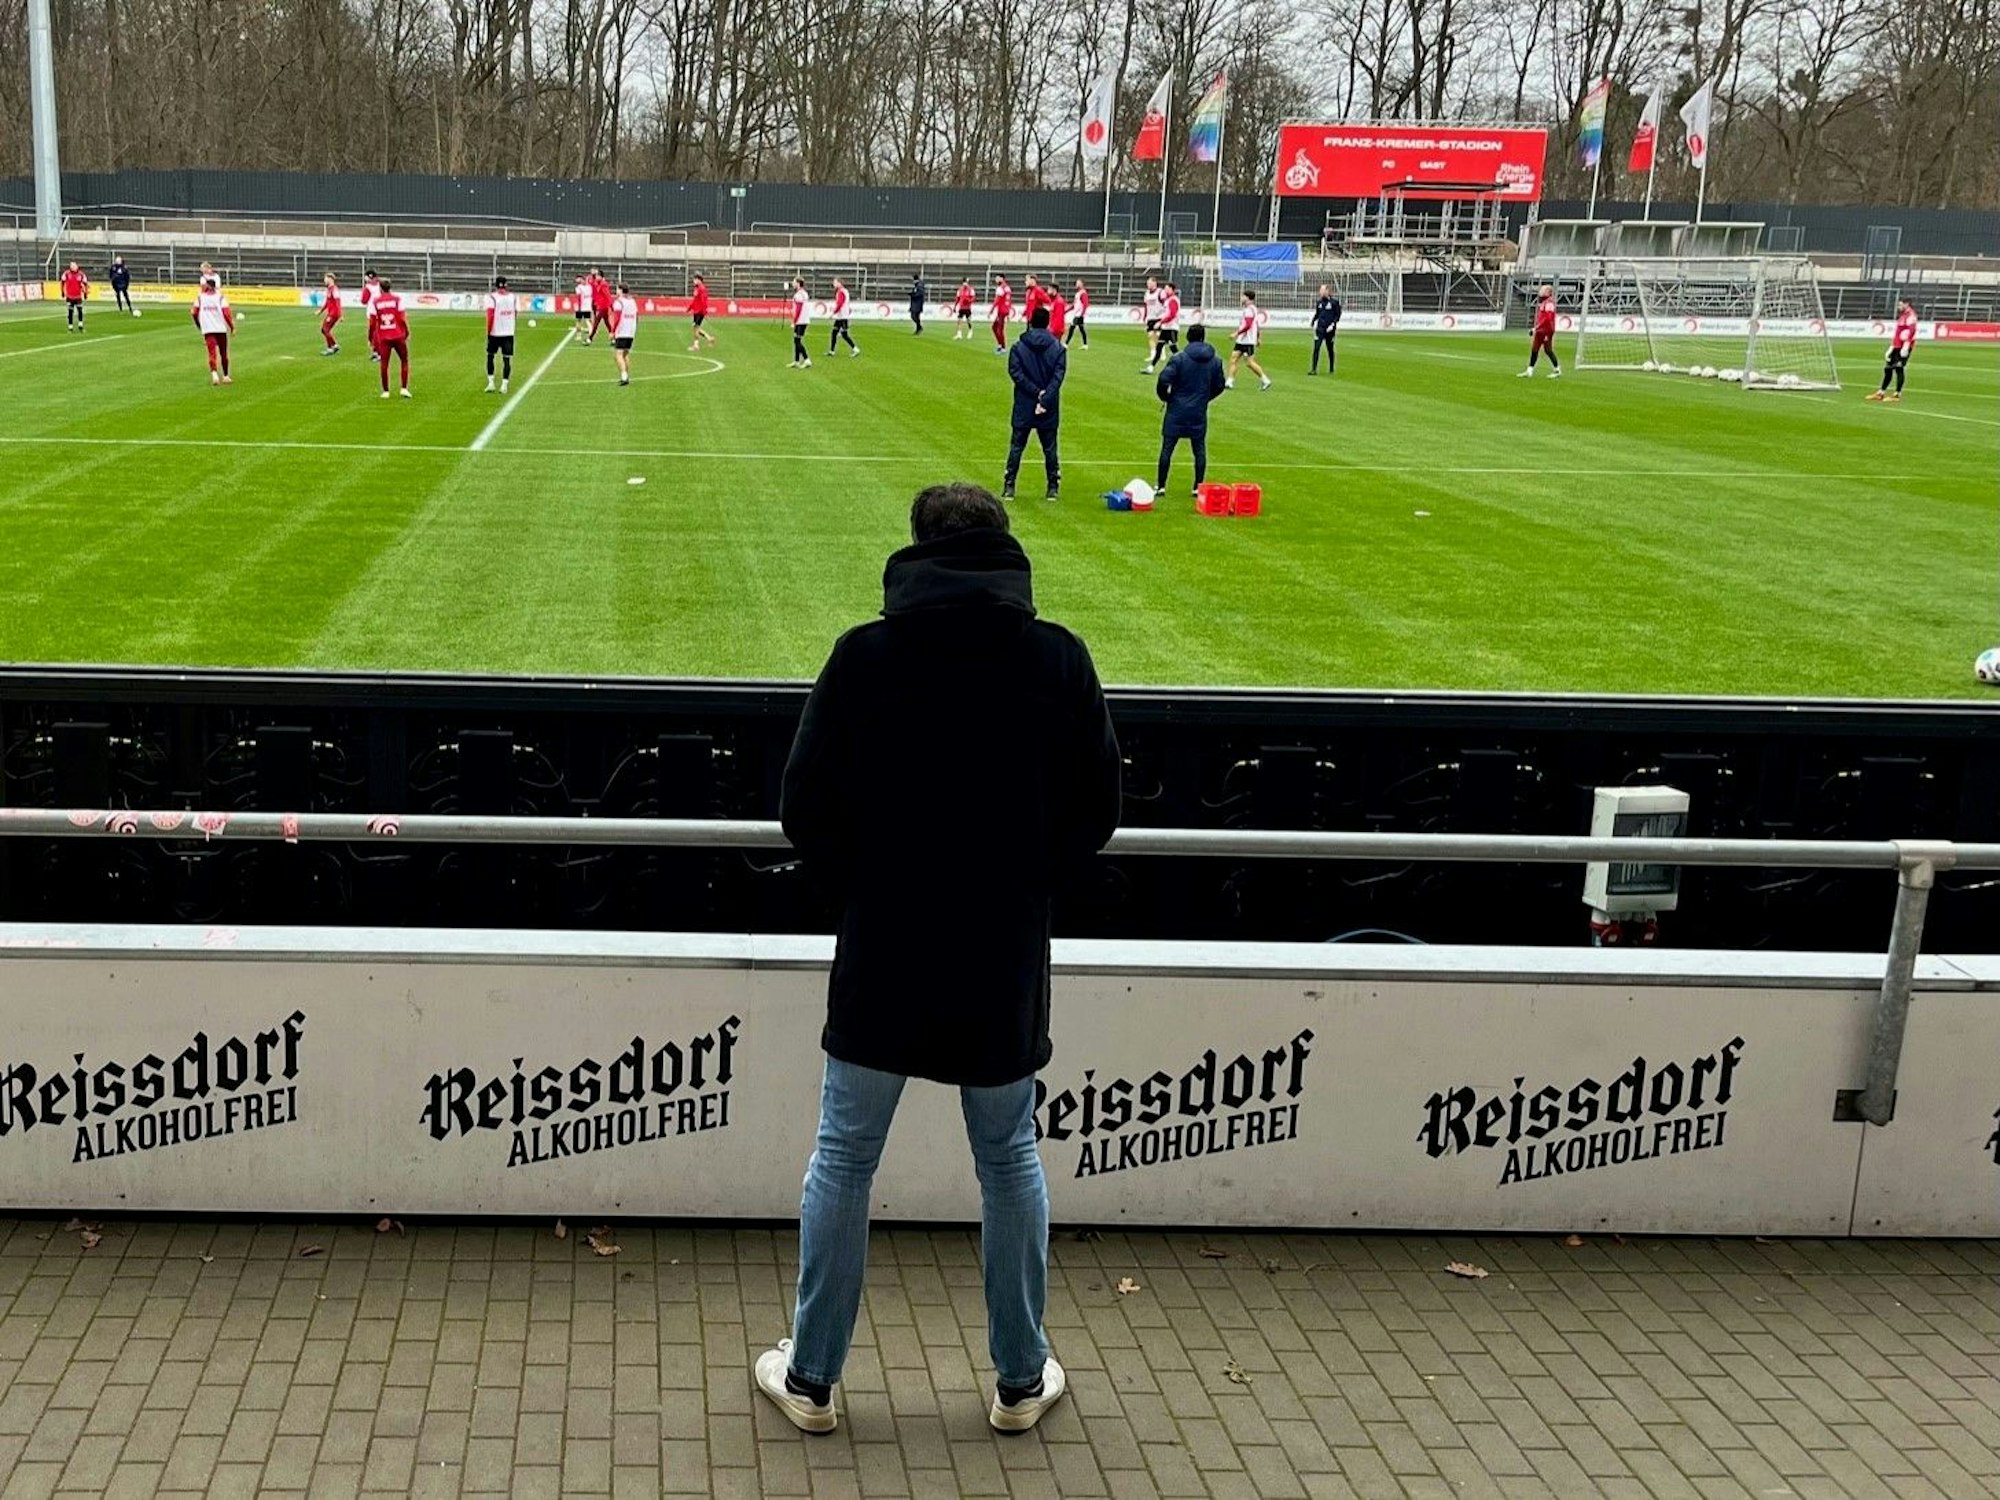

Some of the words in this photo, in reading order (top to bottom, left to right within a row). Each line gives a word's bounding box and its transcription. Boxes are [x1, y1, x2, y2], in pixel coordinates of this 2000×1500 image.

[1323, 137, 1503, 151] FRANZ-KREMER-STADION
[1382, 160, 1396, 169] FC
[1420, 160, 1447, 170] GAST
[1500, 163, 1530, 174] Rhein
[0, 1009, 306, 1137] Reissdorf
[419, 1014, 742, 1141] Reissdorf
[1035, 1028, 1315, 1143] eissdorf
[1416, 1036, 1746, 1159] Reissdorf
[72, 1086, 297, 1163] ALKOHOLFREI
[507, 1091, 730, 1168] ALKOHOLFREI
[1074, 1103, 1300, 1179] ALKOHOLFREI
[1499, 1111, 1727, 1185] ALKOHOLFREI
